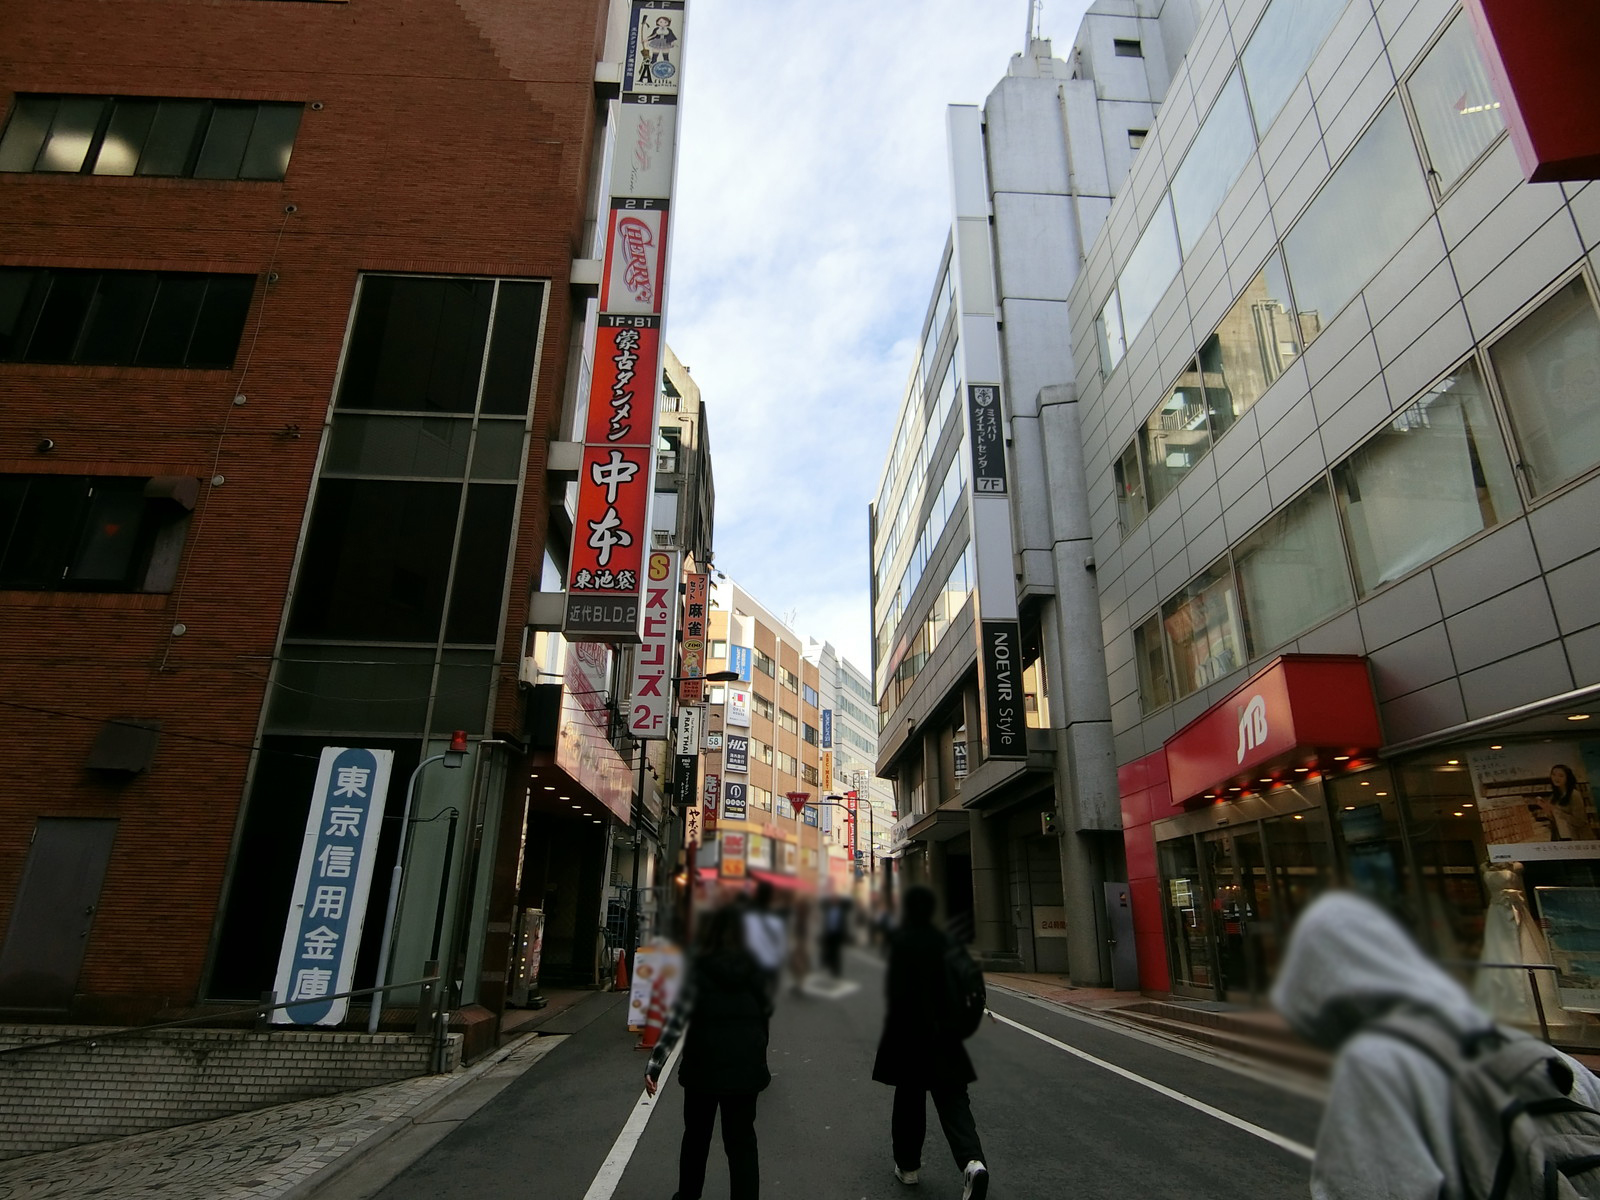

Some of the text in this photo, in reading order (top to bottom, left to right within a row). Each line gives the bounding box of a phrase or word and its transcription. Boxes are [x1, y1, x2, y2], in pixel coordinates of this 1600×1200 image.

[645, 1, 671, 9] 4F
[637, 95, 661, 104] 3F
[625, 199, 654, 209] 2F
[618, 216, 656, 304] CHERRY
[607, 328, 640, 442] 蒙古タンメン
[974, 407, 988, 475] ダイエットセンター
[979, 478, 1001, 491] 7F
[588, 450, 639, 567] 中本
[572, 570, 636, 591] 東池袋
[649, 552, 671, 582] S
[688, 603, 703, 636] 麻雀
[637, 587, 668, 697] スピンズ
[993, 631, 1015, 745] NOEVIR Style
[633, 704, 664, 730] 2F
[1236, 694, 1268, 765] JTB
[708, 737, 719, 746] 58
[727, 739, 748, 751] HIS
[290, 765, 371, 1002] 東京信用金庫
